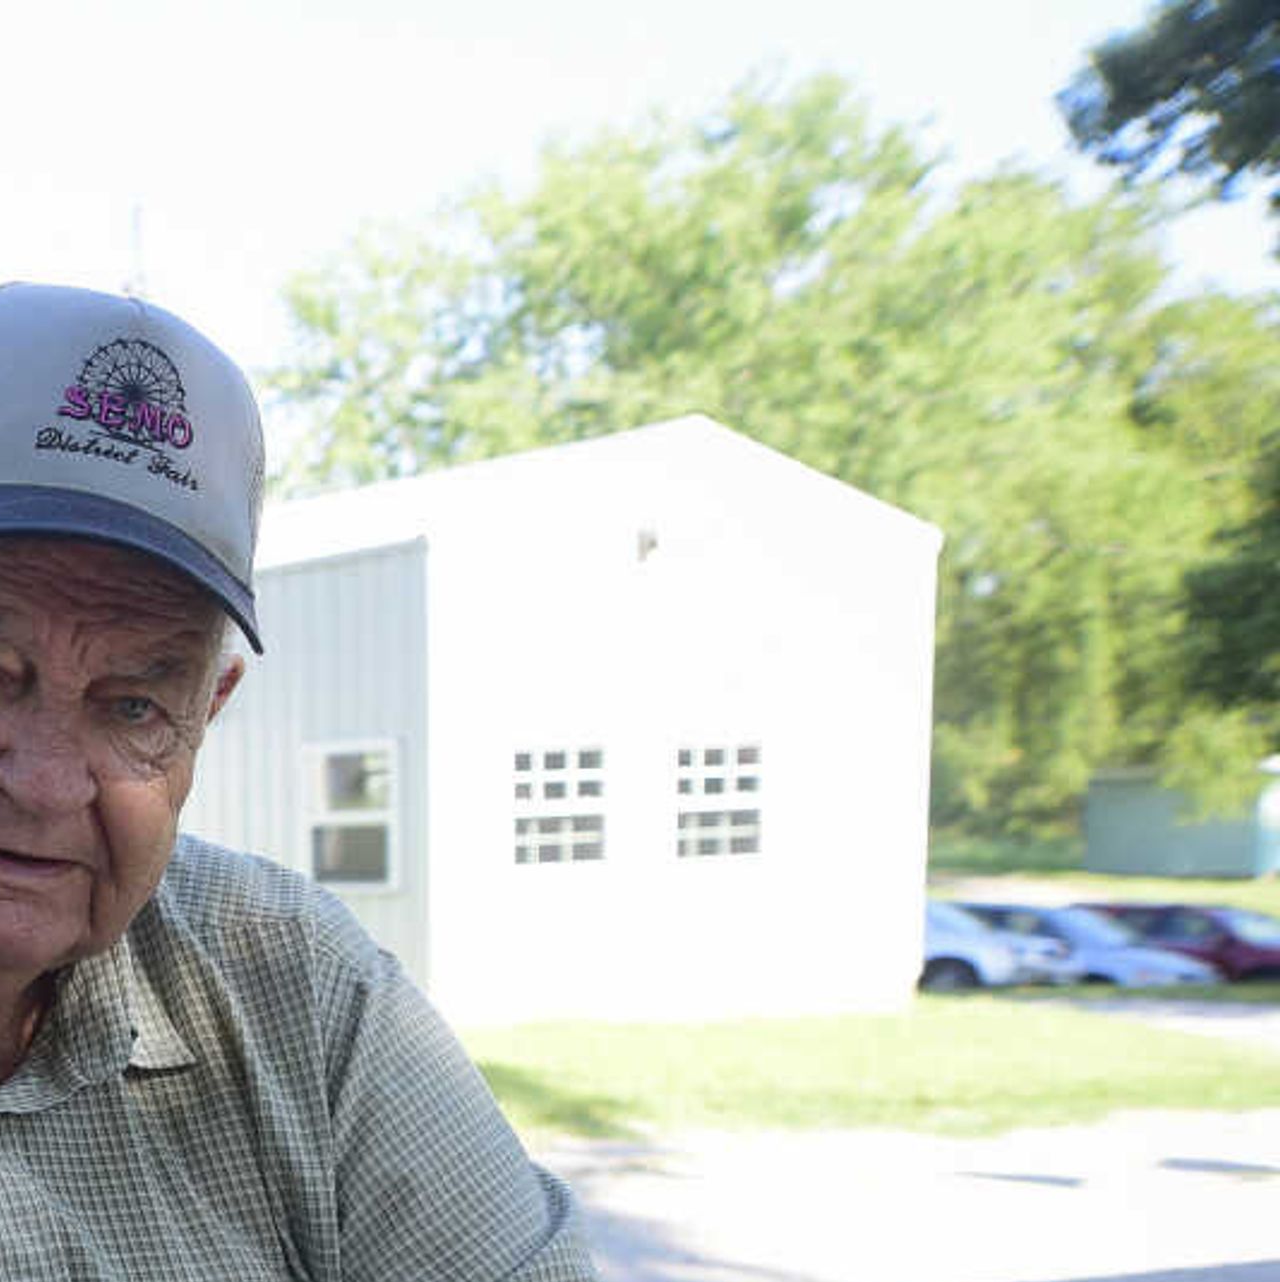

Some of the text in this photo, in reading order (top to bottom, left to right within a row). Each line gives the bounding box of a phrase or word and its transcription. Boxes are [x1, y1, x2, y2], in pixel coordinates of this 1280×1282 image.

[56, 385, 194, 449] SEMO
[35, 427, 199, 491] District Fair
